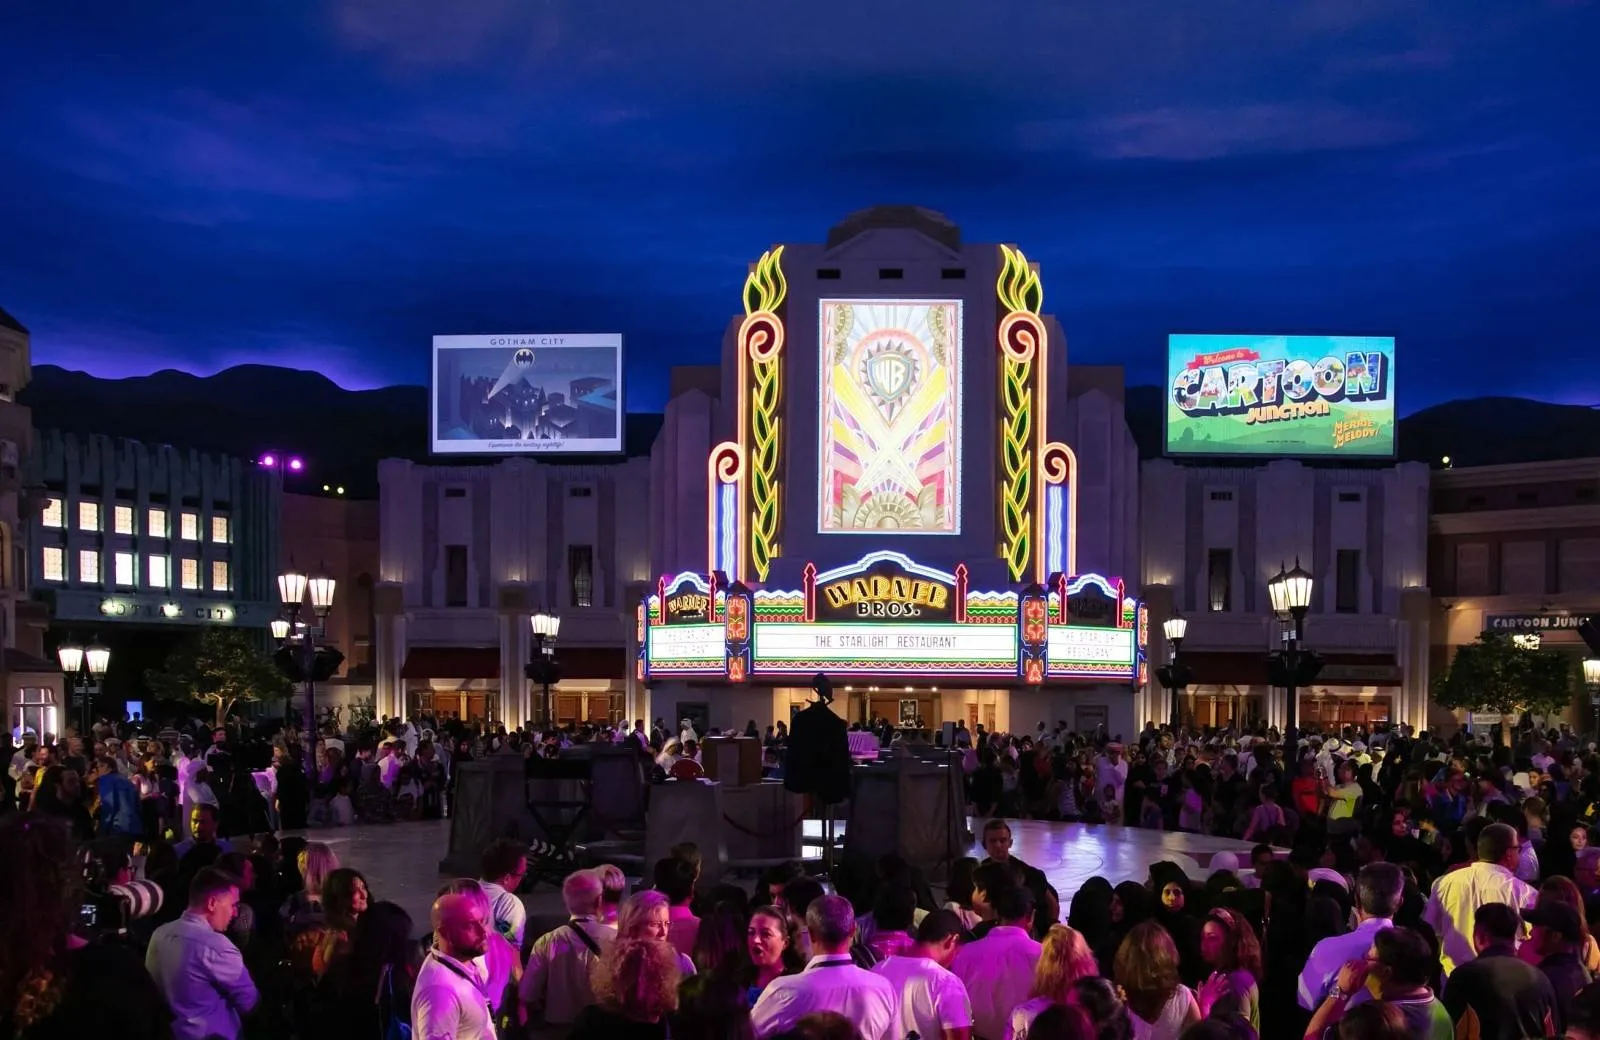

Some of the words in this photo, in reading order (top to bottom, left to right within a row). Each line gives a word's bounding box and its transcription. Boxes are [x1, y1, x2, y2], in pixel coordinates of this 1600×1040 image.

[490, 338, 536, 346] GOTHAM
[541, 337, 566, 345] CITY
[1203, 353, 1235, 364] Welcome
[1172, 352, 1385, 413] CARTOON
[1246, 400, 1330, 424] JUNCTION
[825, 575, 948, 609] WARNER
[668, 594, 709, 612] WARNER
[857, 601, 921, 617] BROS.
[1493, 617, 1550, 628] CARTOON
[815, 635, 832, 647] THE
[839, 635, 889, 647] STARLIGHT
[897, 636, 957, 648] RESTAURANT
